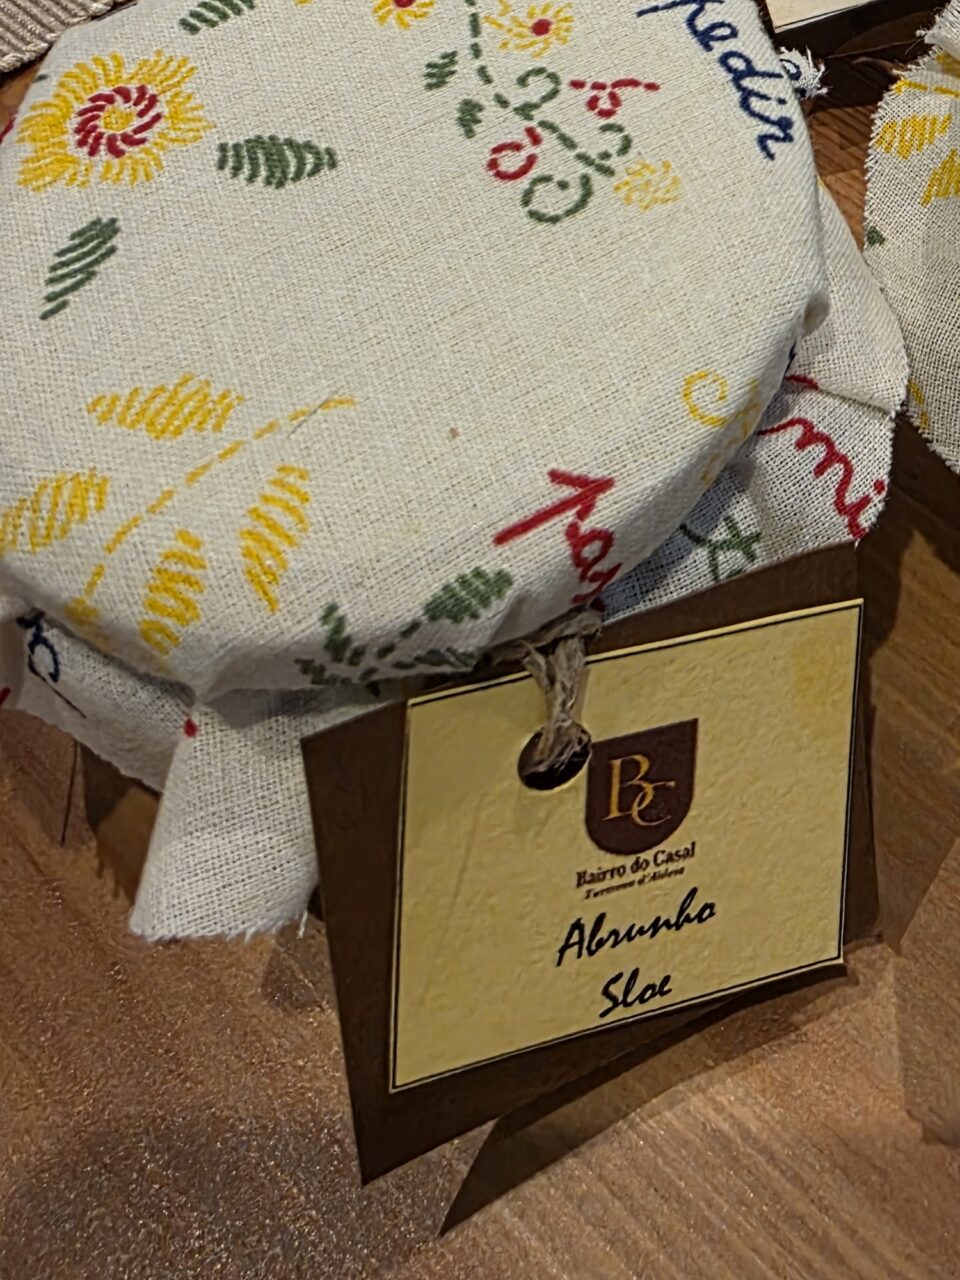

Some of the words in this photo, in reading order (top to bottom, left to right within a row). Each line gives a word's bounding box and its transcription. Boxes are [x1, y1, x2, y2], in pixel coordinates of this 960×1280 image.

[575, 864, 626, 889] Bairro
[630, 856, 650, 874] do
[653, 841, 696, 867] Casal
[556, 886, 716, 968] Abrunho
[599, 967, 672, 1018] Sloe
